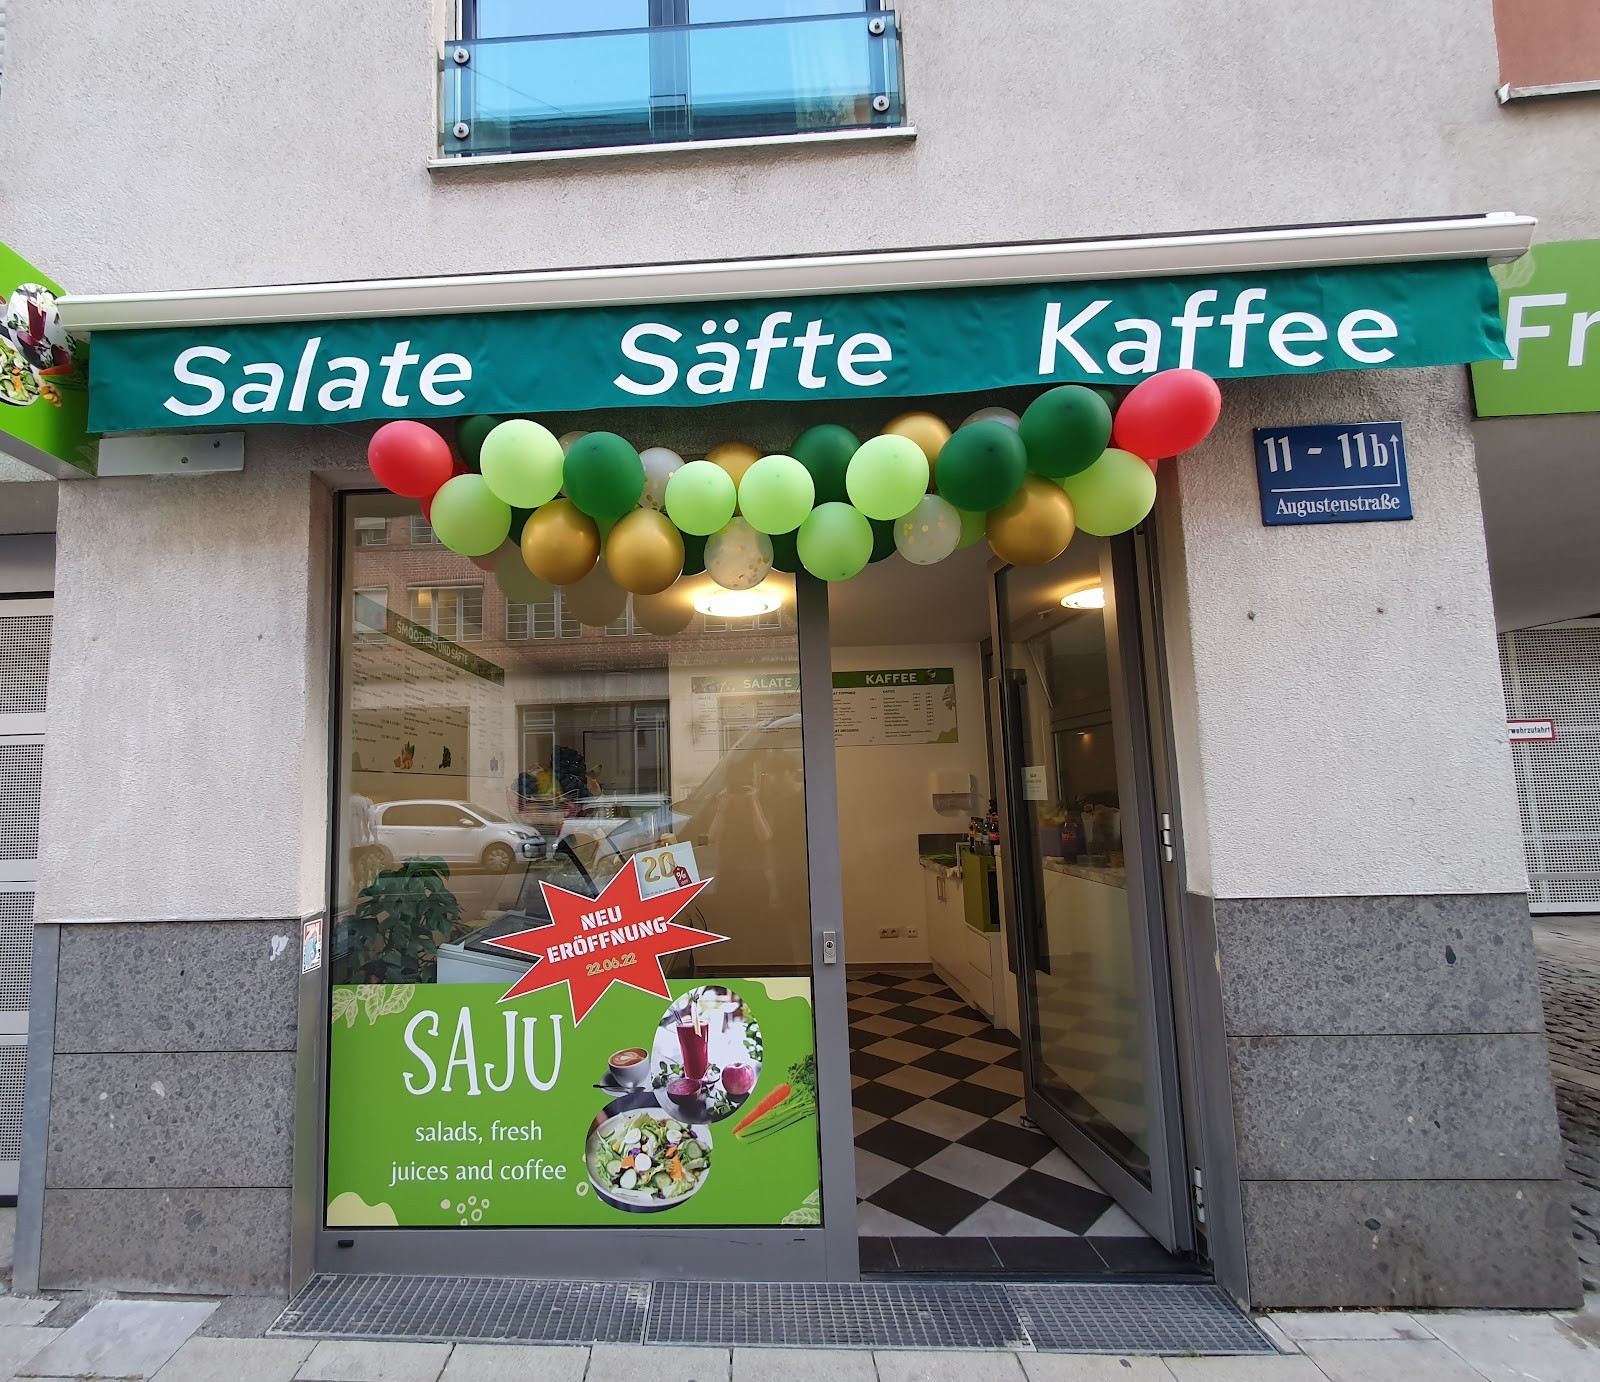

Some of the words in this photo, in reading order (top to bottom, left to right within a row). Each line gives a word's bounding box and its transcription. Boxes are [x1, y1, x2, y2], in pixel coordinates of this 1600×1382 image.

[164, 338, 472, 416] Salate
[613, 311, 892, 396] Säfte
[1038, 289, 1398, 375] Kaffee
[1263, 436, 1293, 473] 11
[1337, 432, 1389, 469] 11b
[1276, 493, 1400, 518] Augustenstraße
[396, 621, 438, 651] SMOOTHIES
[438, 642, 451, 656] UND
[743, 677, 793, 689] SALATE
[865, 672, 917, 686] KAFFEE
[641, 851, 676, 883] 20
[580, 905, 622, 931] NEU
[546, 916, 669, 964] ERÖFFNUNG
[586, 952, 638, 977] 22.06.22
[402, 1006, 563, 1095] SAJU
[415, 1120, 484, 1145] salads,
[490, 1119, 542, 1142] fresh
[388, 1160, 449, 1187] juices
[455, 1159, 493, 1181] and
[499, 1158, 567, 1181] coffee
